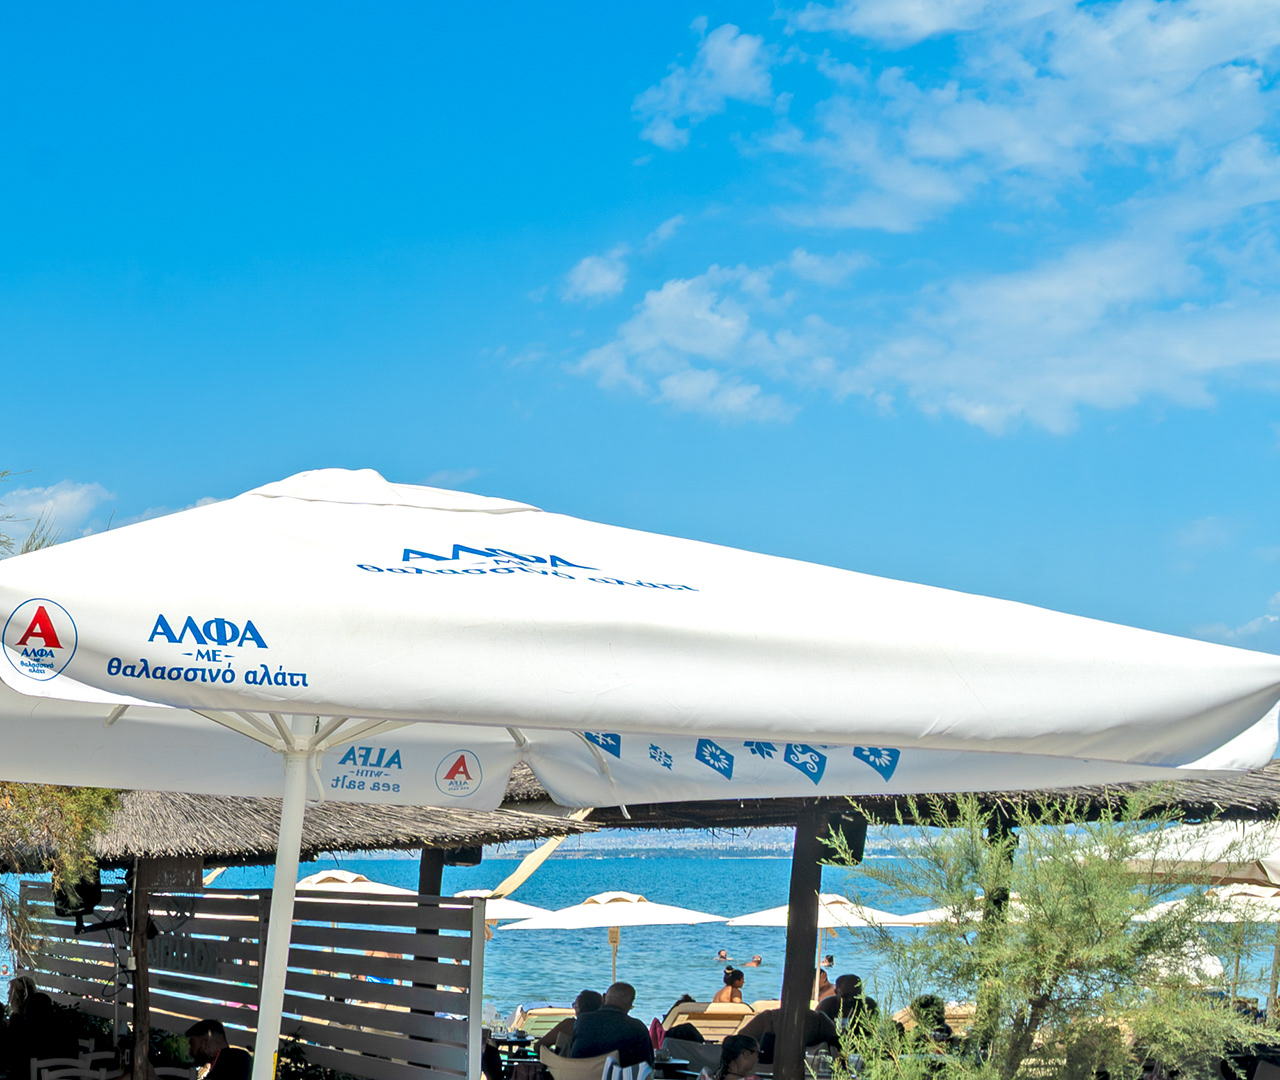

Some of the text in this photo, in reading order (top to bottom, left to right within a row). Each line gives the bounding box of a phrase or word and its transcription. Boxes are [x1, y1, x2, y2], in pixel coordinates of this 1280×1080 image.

[148, 614, 269, 649] ΑΛΦΑ
[21, 648, 55, 658] ΑΛΦΑ
[107, 657, 308, 687] θαλασσινό αλάτι
